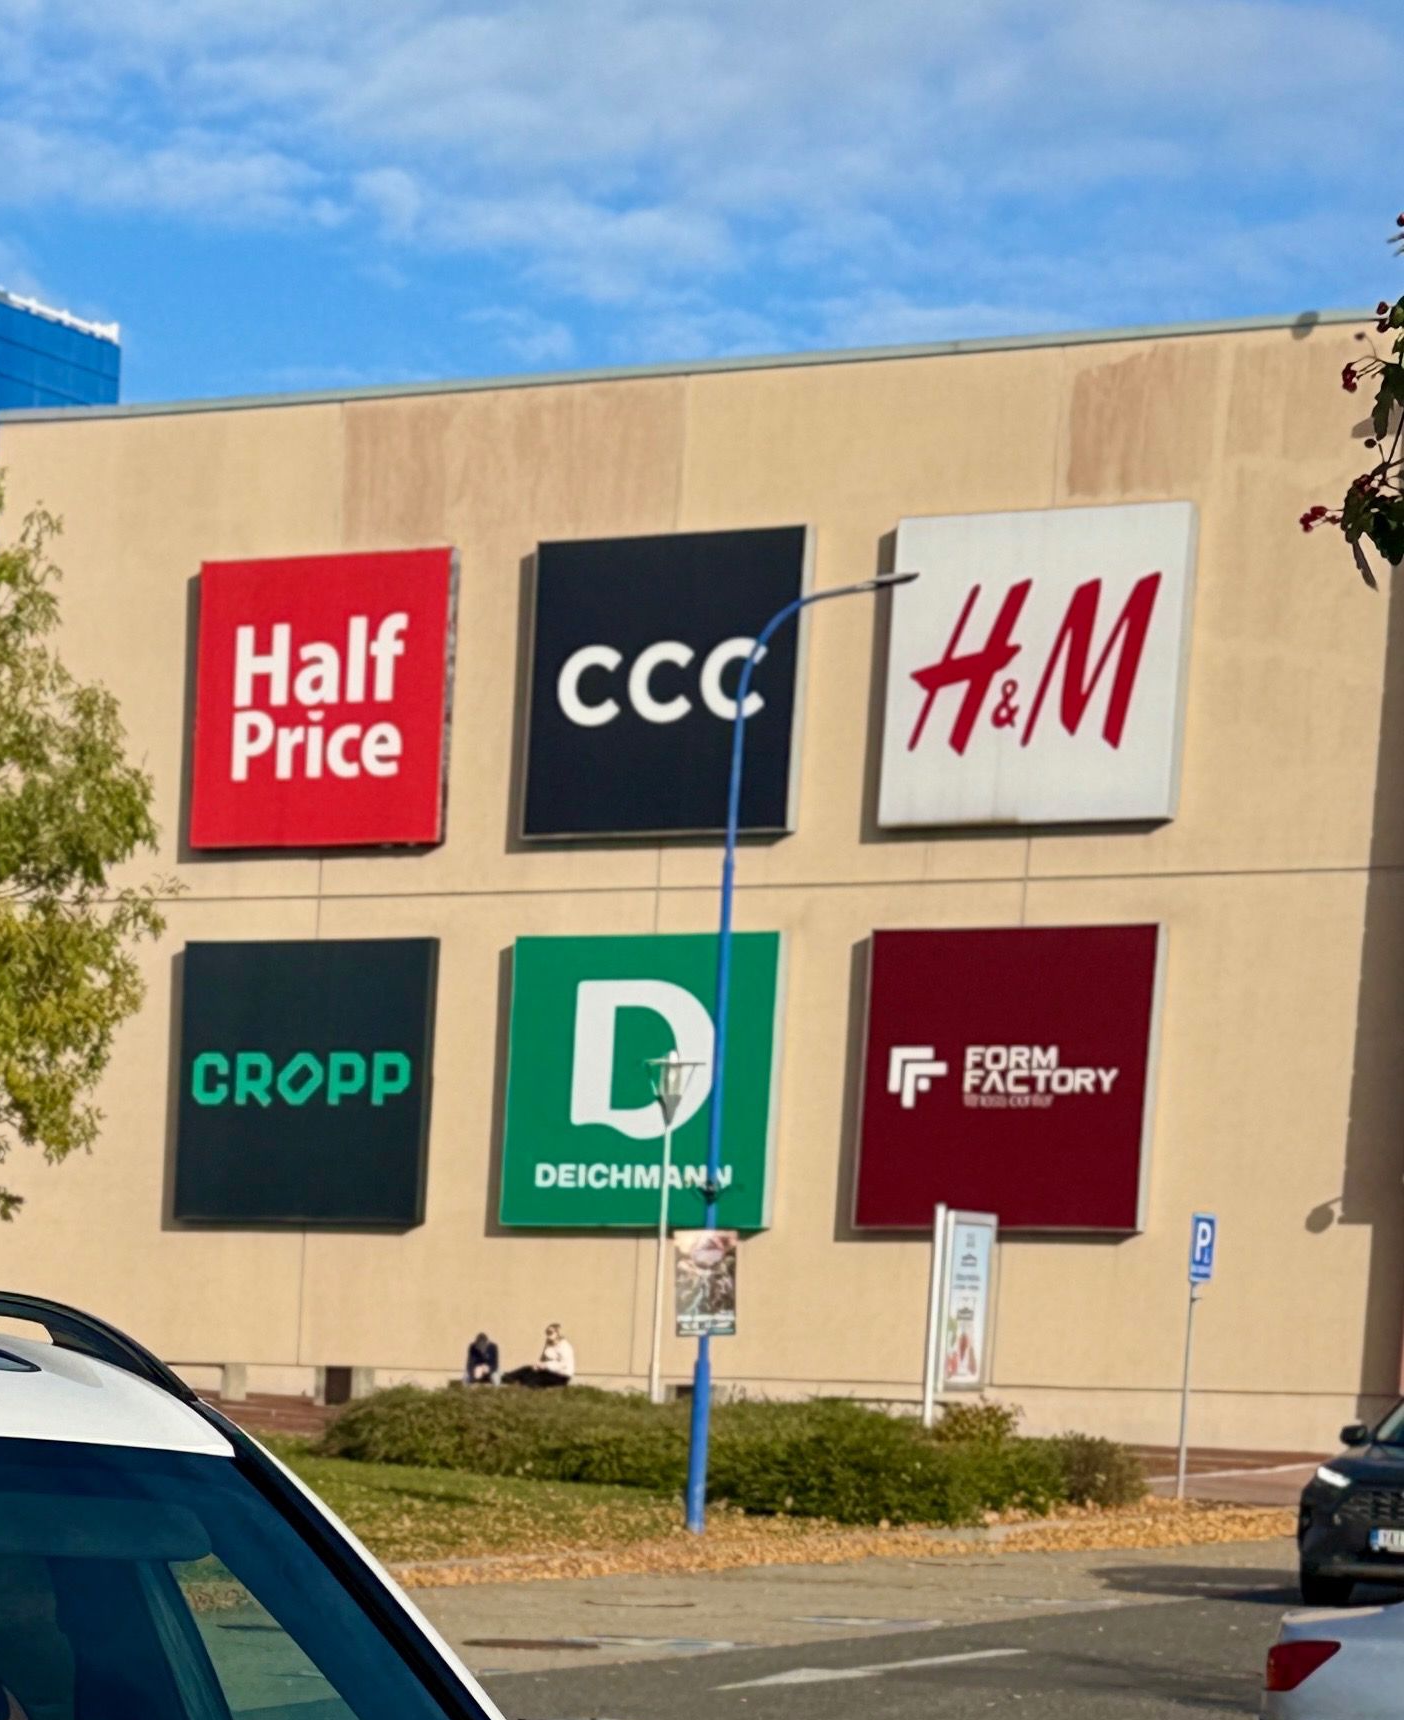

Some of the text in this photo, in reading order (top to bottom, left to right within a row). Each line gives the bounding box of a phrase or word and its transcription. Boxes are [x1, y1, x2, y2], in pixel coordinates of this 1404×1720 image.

[232, 612, 408, 708] Half
[557, 637, 768, 727] CCC
[908, 571, 1162, 756] H&M
[230, 710, 404, 781] Price
[192, 1052, 411, 1107] CROPP
[963, 1068, 1119, 1094] FACTORY
[965, 1045, 1059, 1070] FORM
[534, 1162, 733, 1190] DEICHMANN
[1195, 1221, 1212, 1262] P
